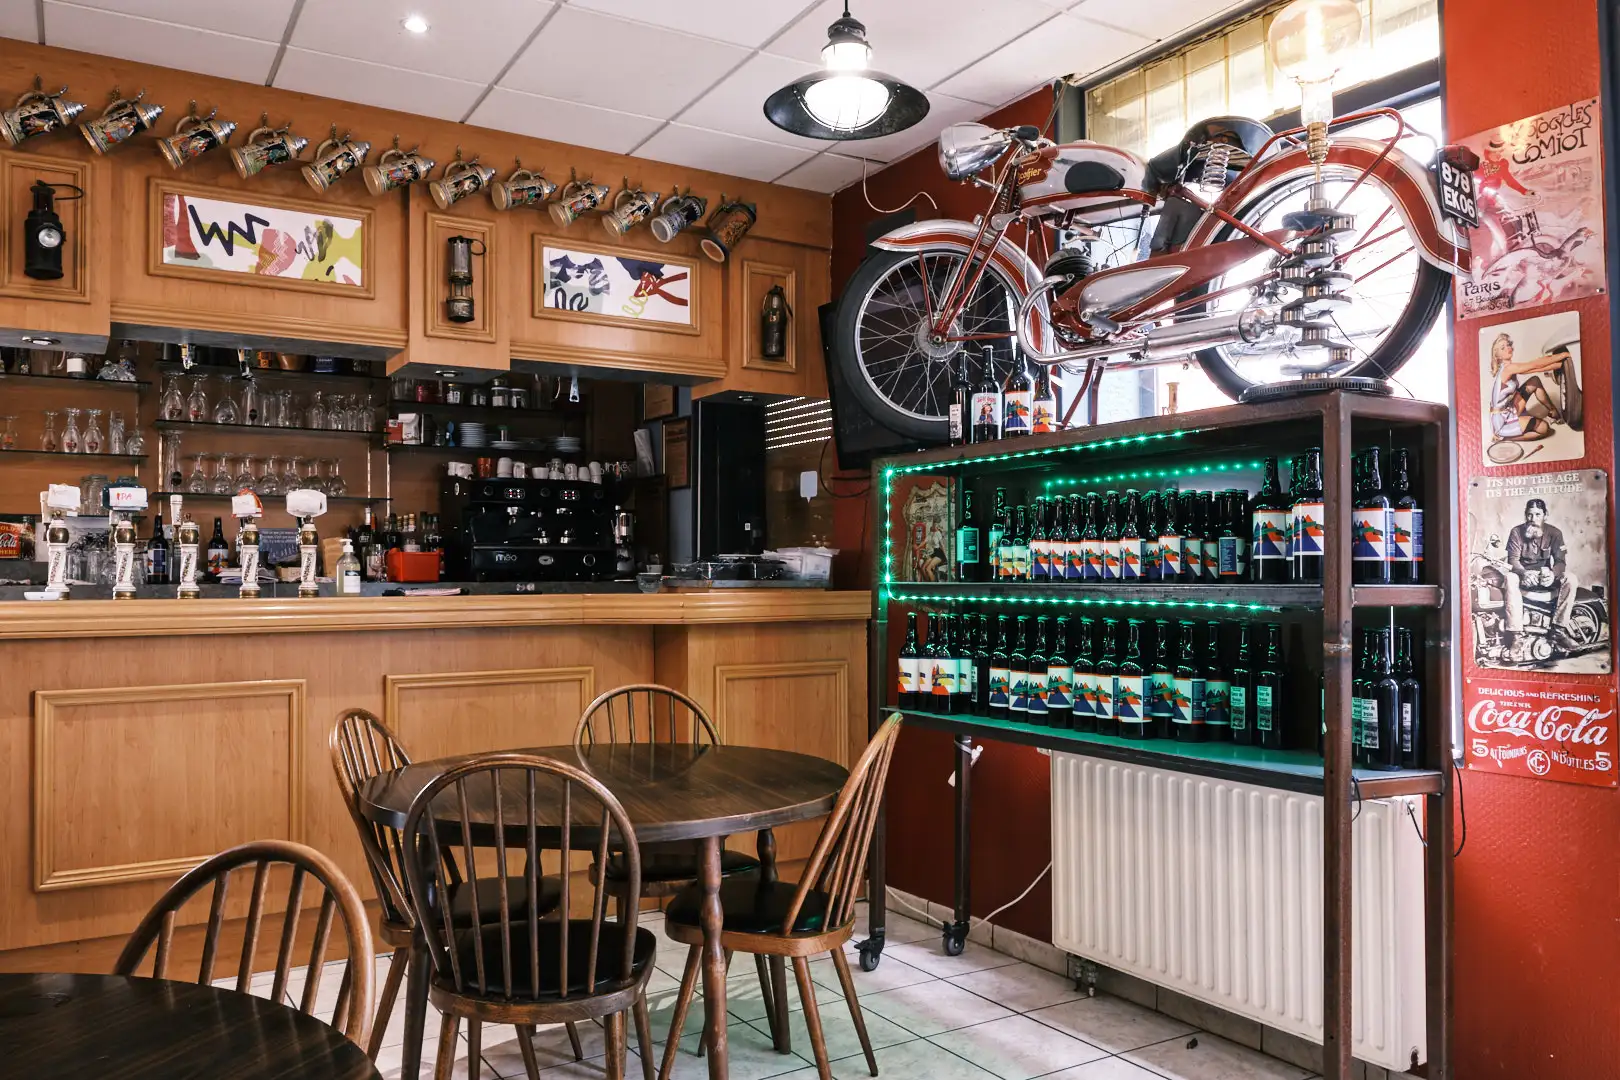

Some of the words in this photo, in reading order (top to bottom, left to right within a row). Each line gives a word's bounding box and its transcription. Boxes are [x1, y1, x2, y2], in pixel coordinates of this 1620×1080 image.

[1441, 161, 1471, 194] 878
[1443, 184, 1475, 219] EK06
[1505, 476, 1528, 486] NOT
[1530, 474, 1553, 485] THE
[1556, 472, 1580, 483] AGE
[1504, 487, 1525, 497] THE
[1528, 483, 1584, 496] ATTITUDE
[1478, 687, 1525, 697] DELICIOUS
[1540, 691, 1601, 703] REFRESHING
[1468, 699, 1613, 745] Coca-Cola
[1551, 750, 1559, 761] IN
[1559, 751, 1595, 771] BOTTLES
